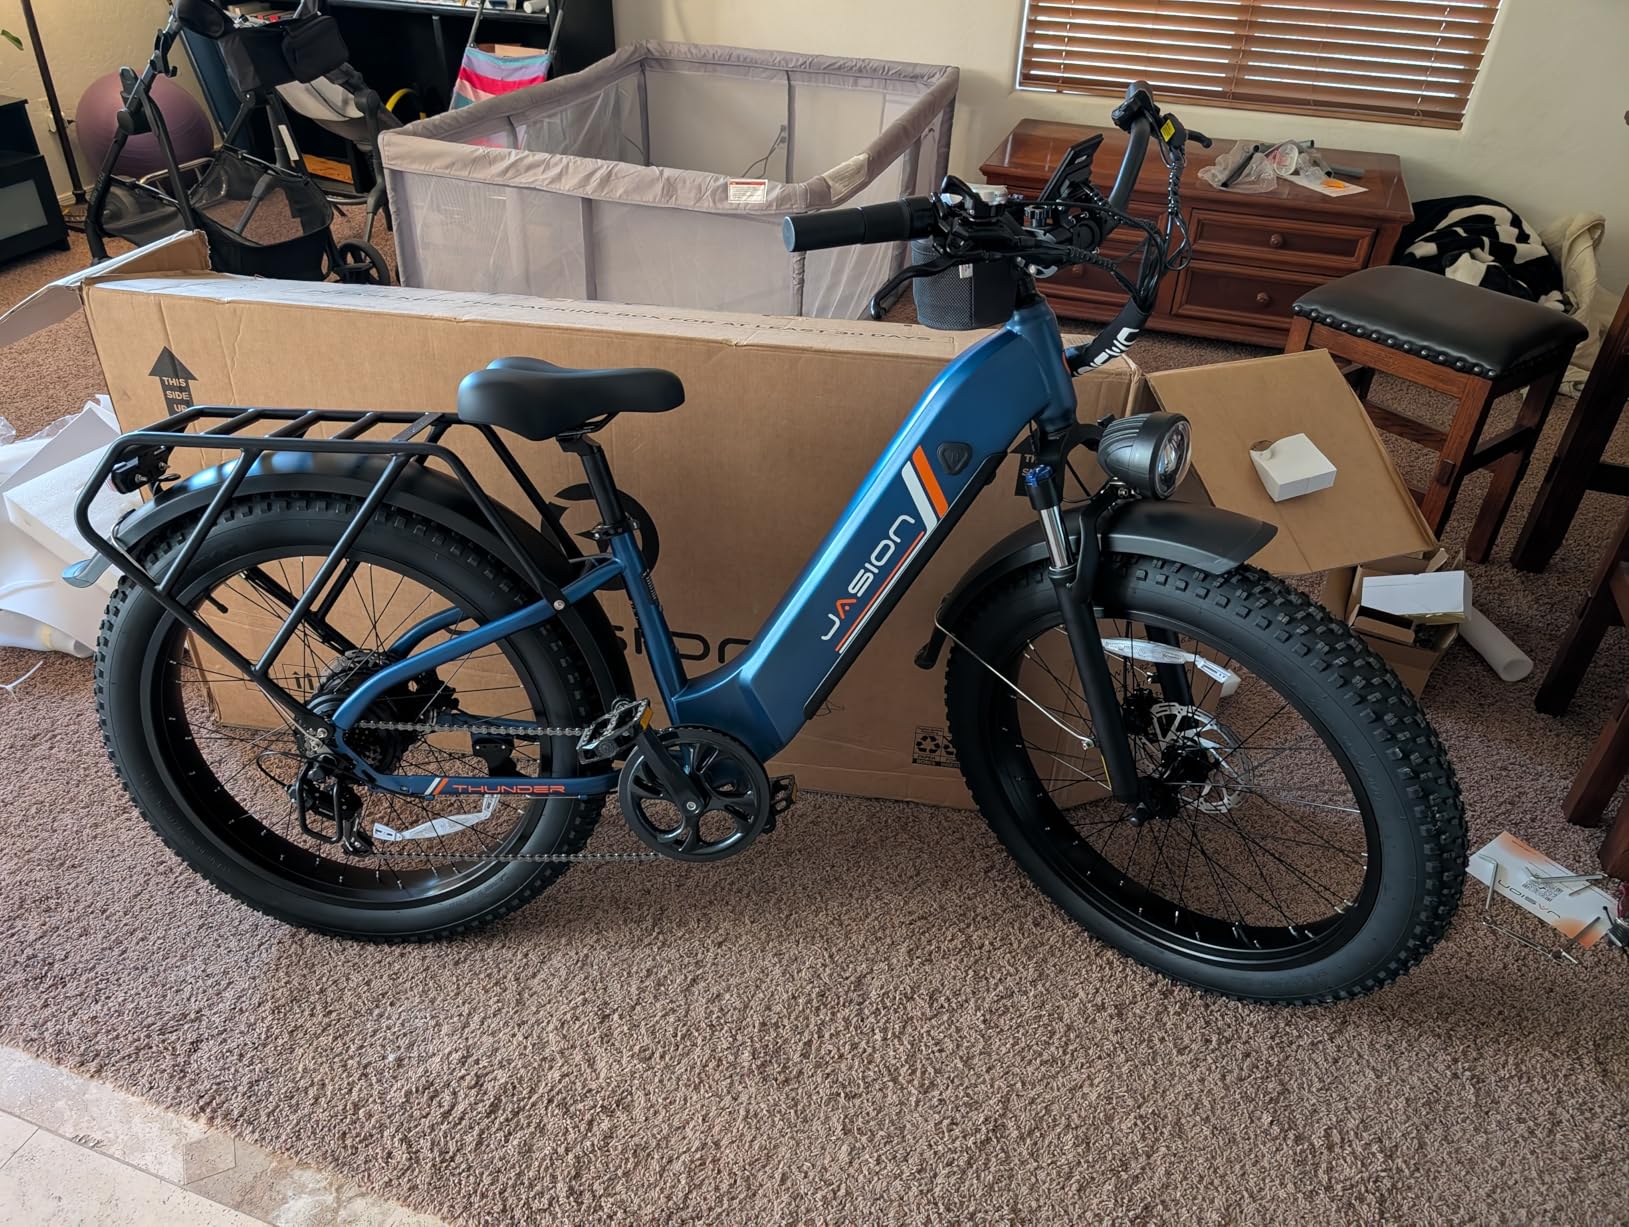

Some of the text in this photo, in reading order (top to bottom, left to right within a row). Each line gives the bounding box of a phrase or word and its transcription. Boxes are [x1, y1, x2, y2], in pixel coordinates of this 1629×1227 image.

[509, 304, 609, 315] PACKING
[755, 324, 825, 334] LEAST
[870, 333, 932, 341] DAYS
[161, 376, 187, 387] THIS
[166, 390, 190, 400] SIDE
[821, 514, 916, 641] JASION
[452, 785, 566, 793] THUNDER
